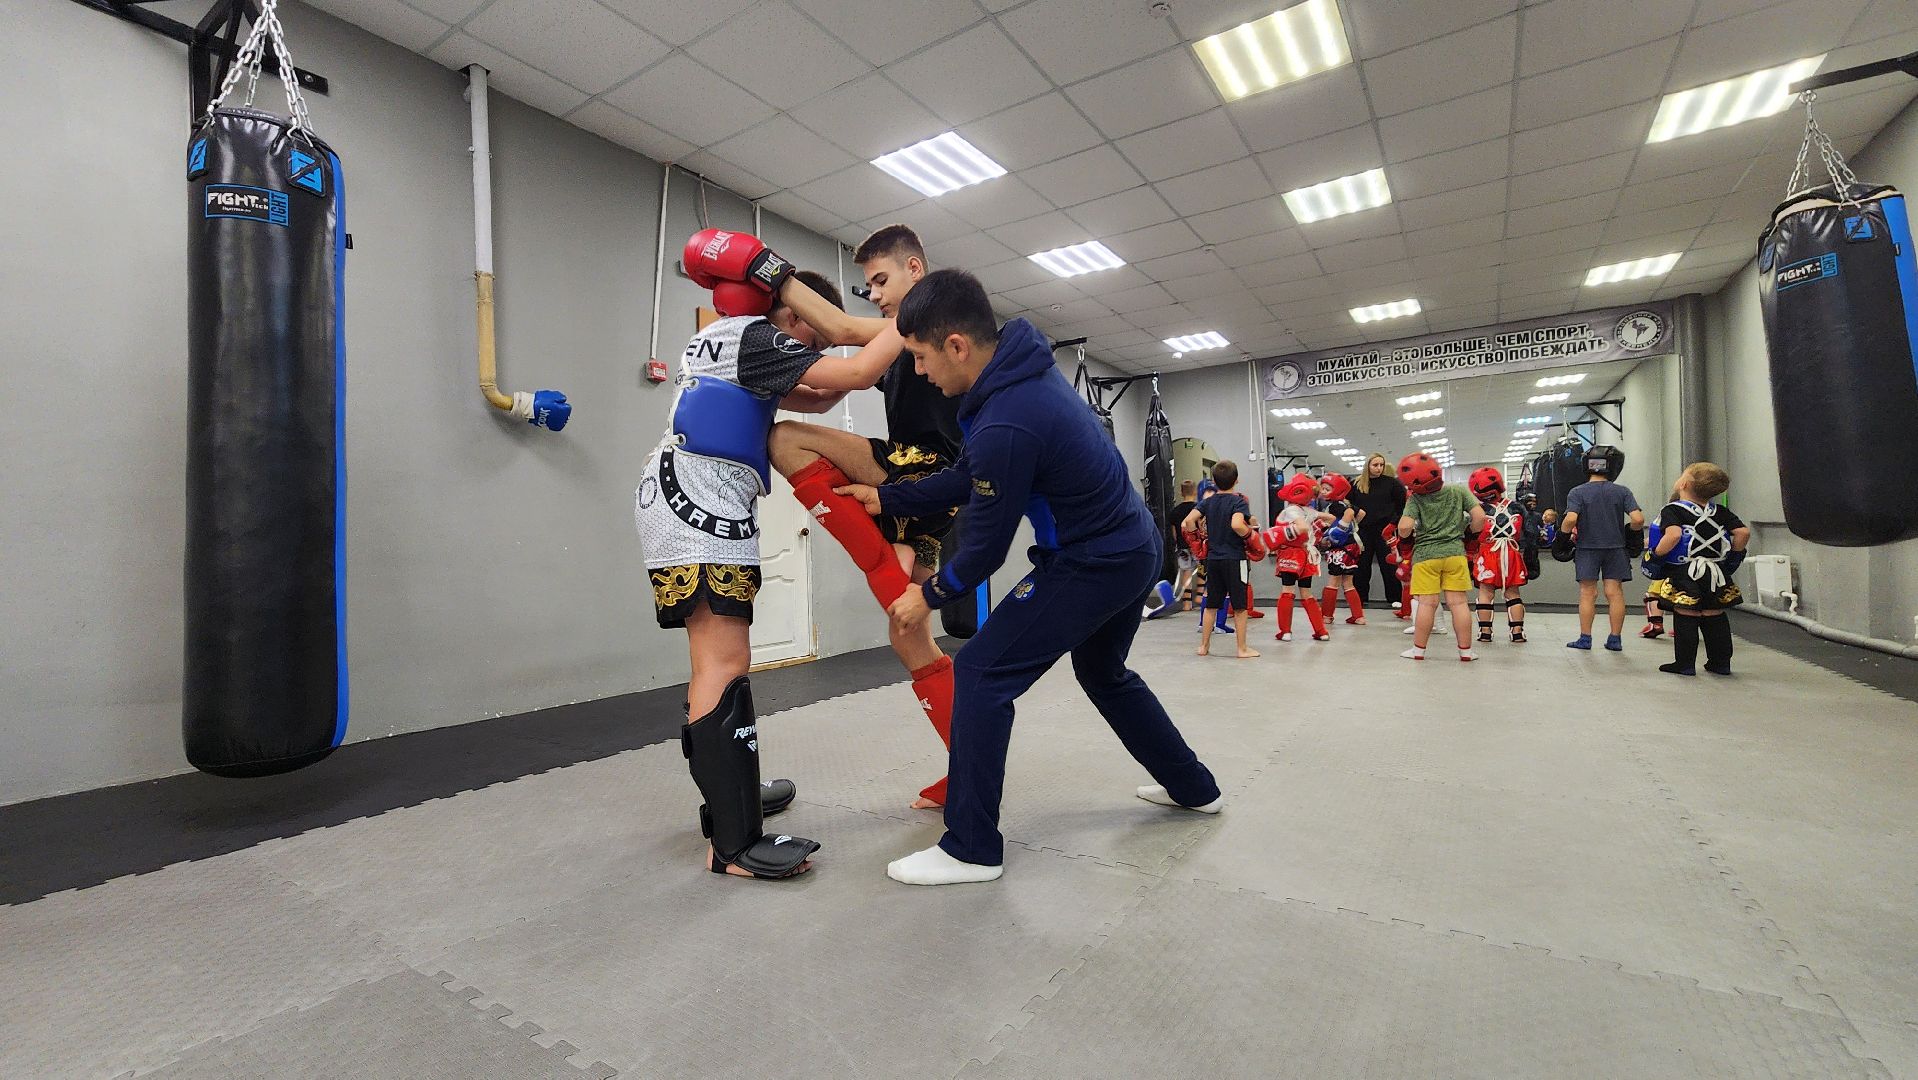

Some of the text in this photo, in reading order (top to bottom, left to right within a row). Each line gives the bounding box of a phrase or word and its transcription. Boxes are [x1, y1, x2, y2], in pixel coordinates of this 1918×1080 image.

[207, 192, 259, 207] FIGHT
[271, 192, 287, 223] LIGHT
[1777, 264, 1813, 282] FIGHT
[686, 338, 723, 362] EN
[1308, 374, 1331, 386] ЭТО
[1420, 351, 1504, 371] ИСКУССТВО
[1509, 338, 1608, 361] ПОБЕЖДАТЬ
[1318, 351, 1378, 371] МУАЙТАЙ
[1394, 348, 1419, 361] ЭТО
[1424, 339, 1491, 357] БОЛЬШЕ,
[1496, 332, 1530, 347] ЧЕМ
[733, 725, 757, 739] REW
